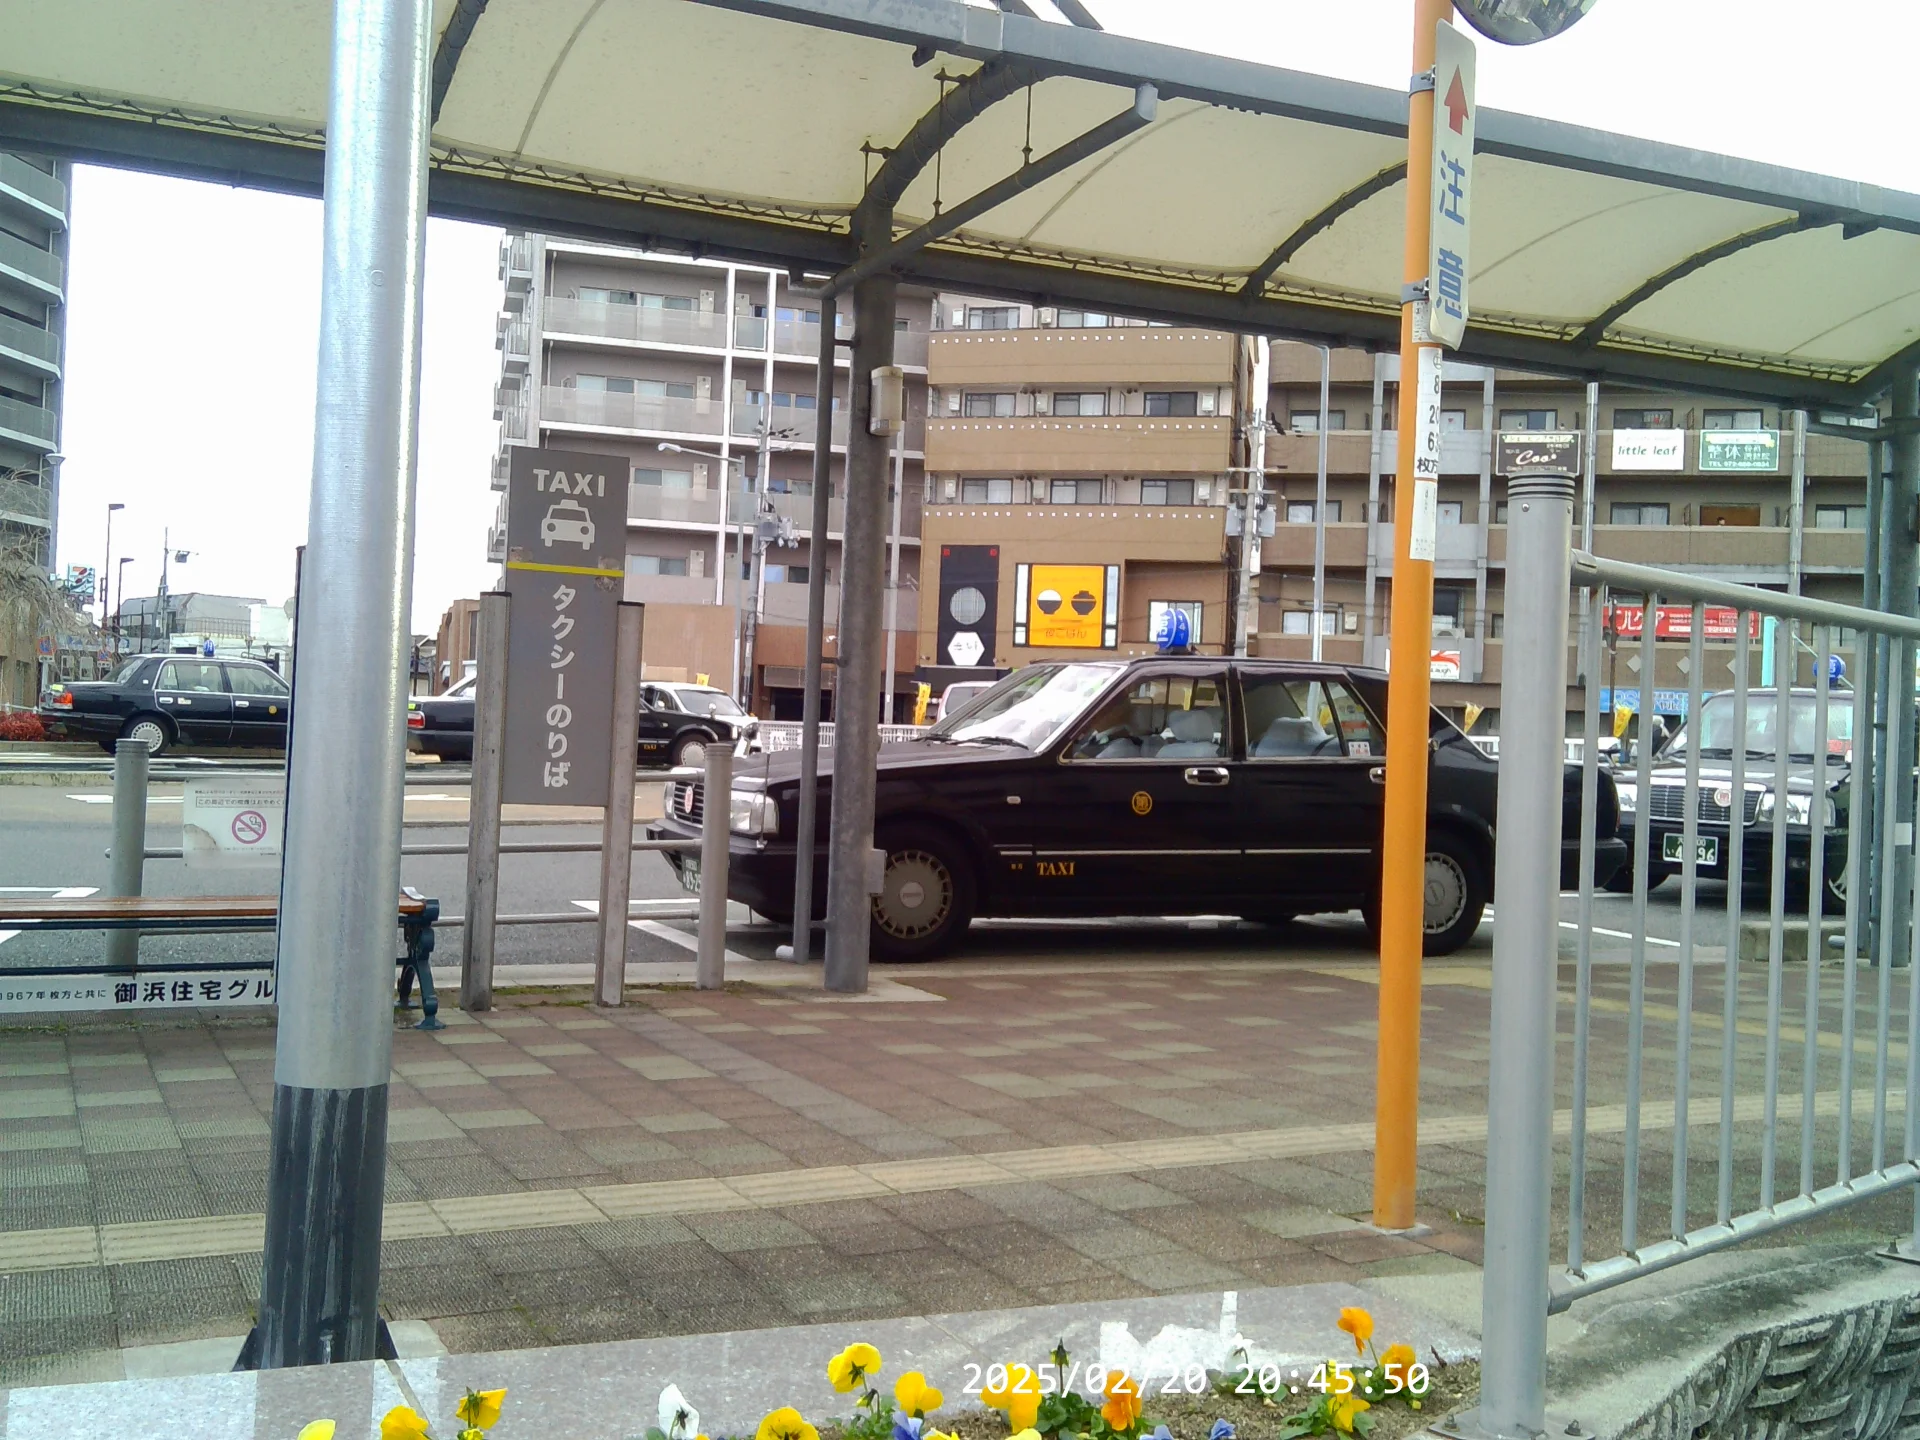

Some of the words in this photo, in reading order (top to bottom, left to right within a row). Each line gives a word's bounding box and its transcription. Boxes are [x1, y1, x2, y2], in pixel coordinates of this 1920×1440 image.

[1435, 149, 1466, 320] 注意
[1618, 445, 1647, 456] little
[1653, 445, 1678, 456] leaf
[532, 468, 605, 497] TAXI
[543, 584, 577, 788] タクシーのりば
[1036, 861, 1076, 876] TAXI
